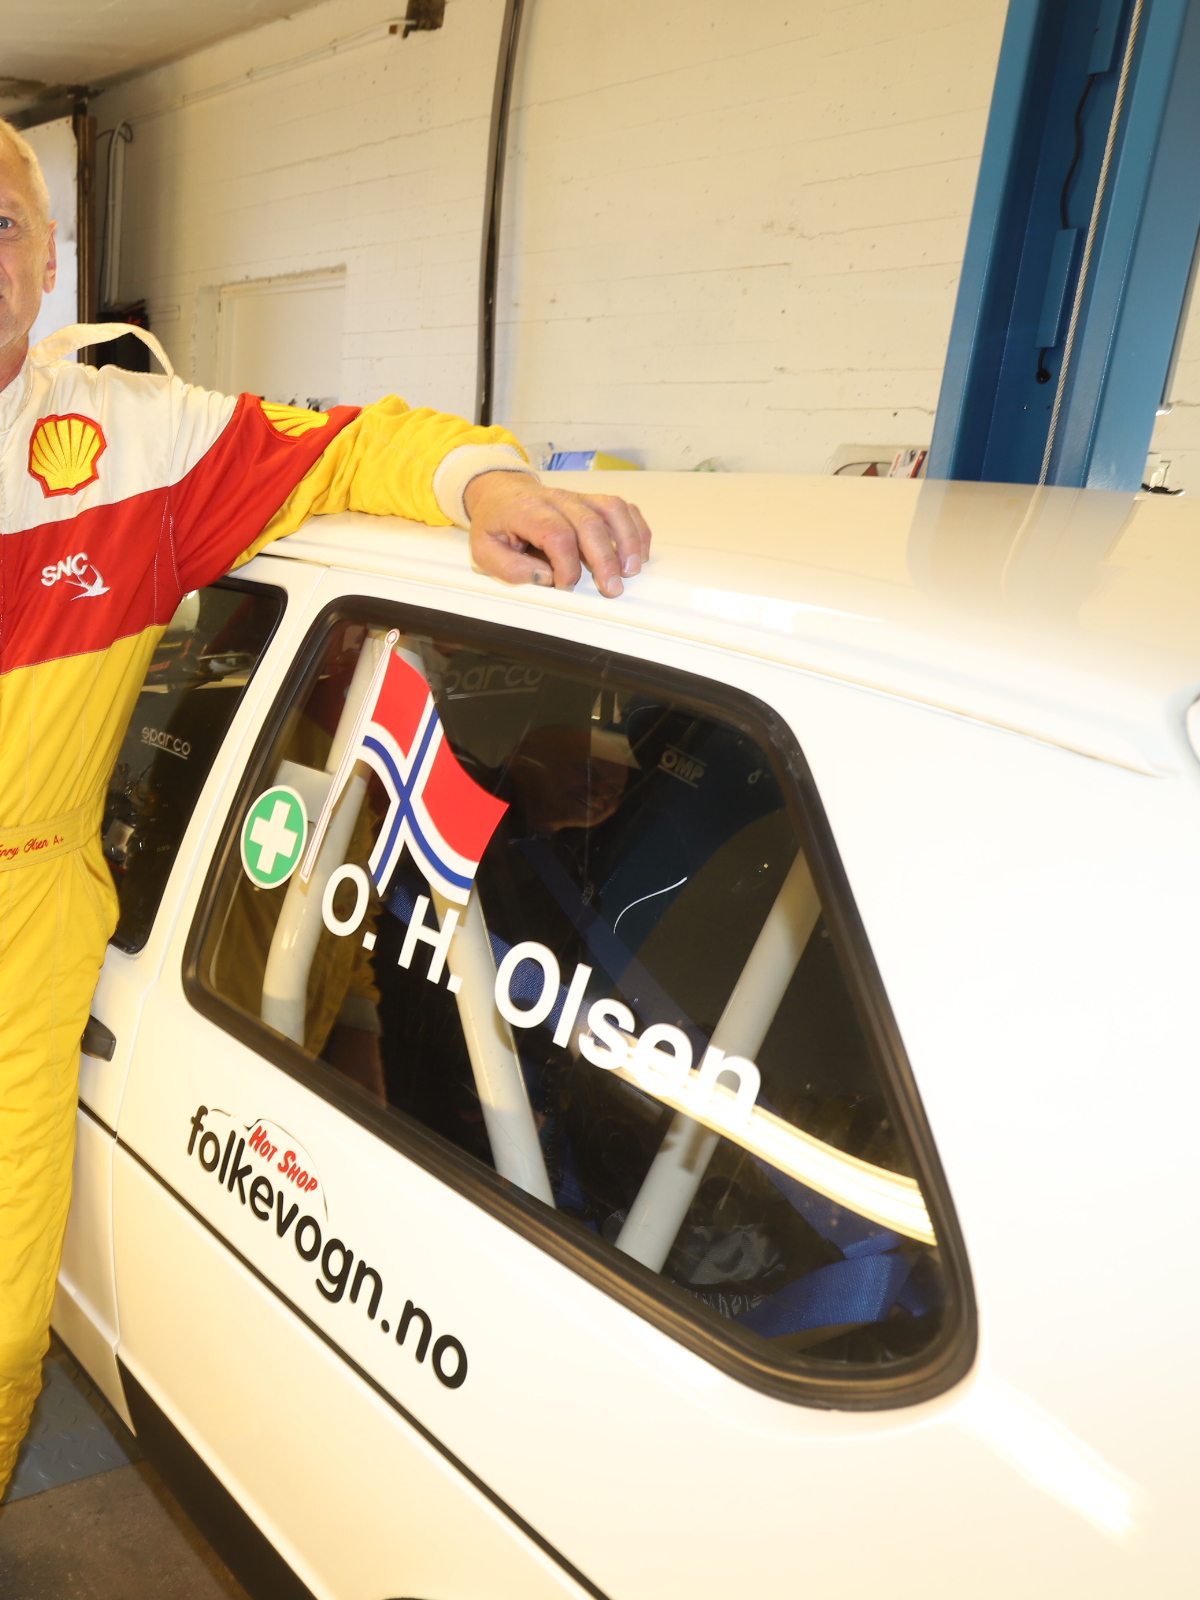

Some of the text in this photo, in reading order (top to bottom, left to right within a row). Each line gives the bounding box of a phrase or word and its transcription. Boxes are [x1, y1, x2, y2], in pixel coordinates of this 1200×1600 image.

[41, 552, 89, 587] SNC
[140, 726, 191, 760] sparco
[659, 747, 706, 785] OMP
[23, 838, 49, 853] Olsen
[321, 863, 762, 1124] O. H. Olsen
[248, 1125, 318, 1194] HOT SHOP
[187, 1105, 468, 1390] folkevogn.no
